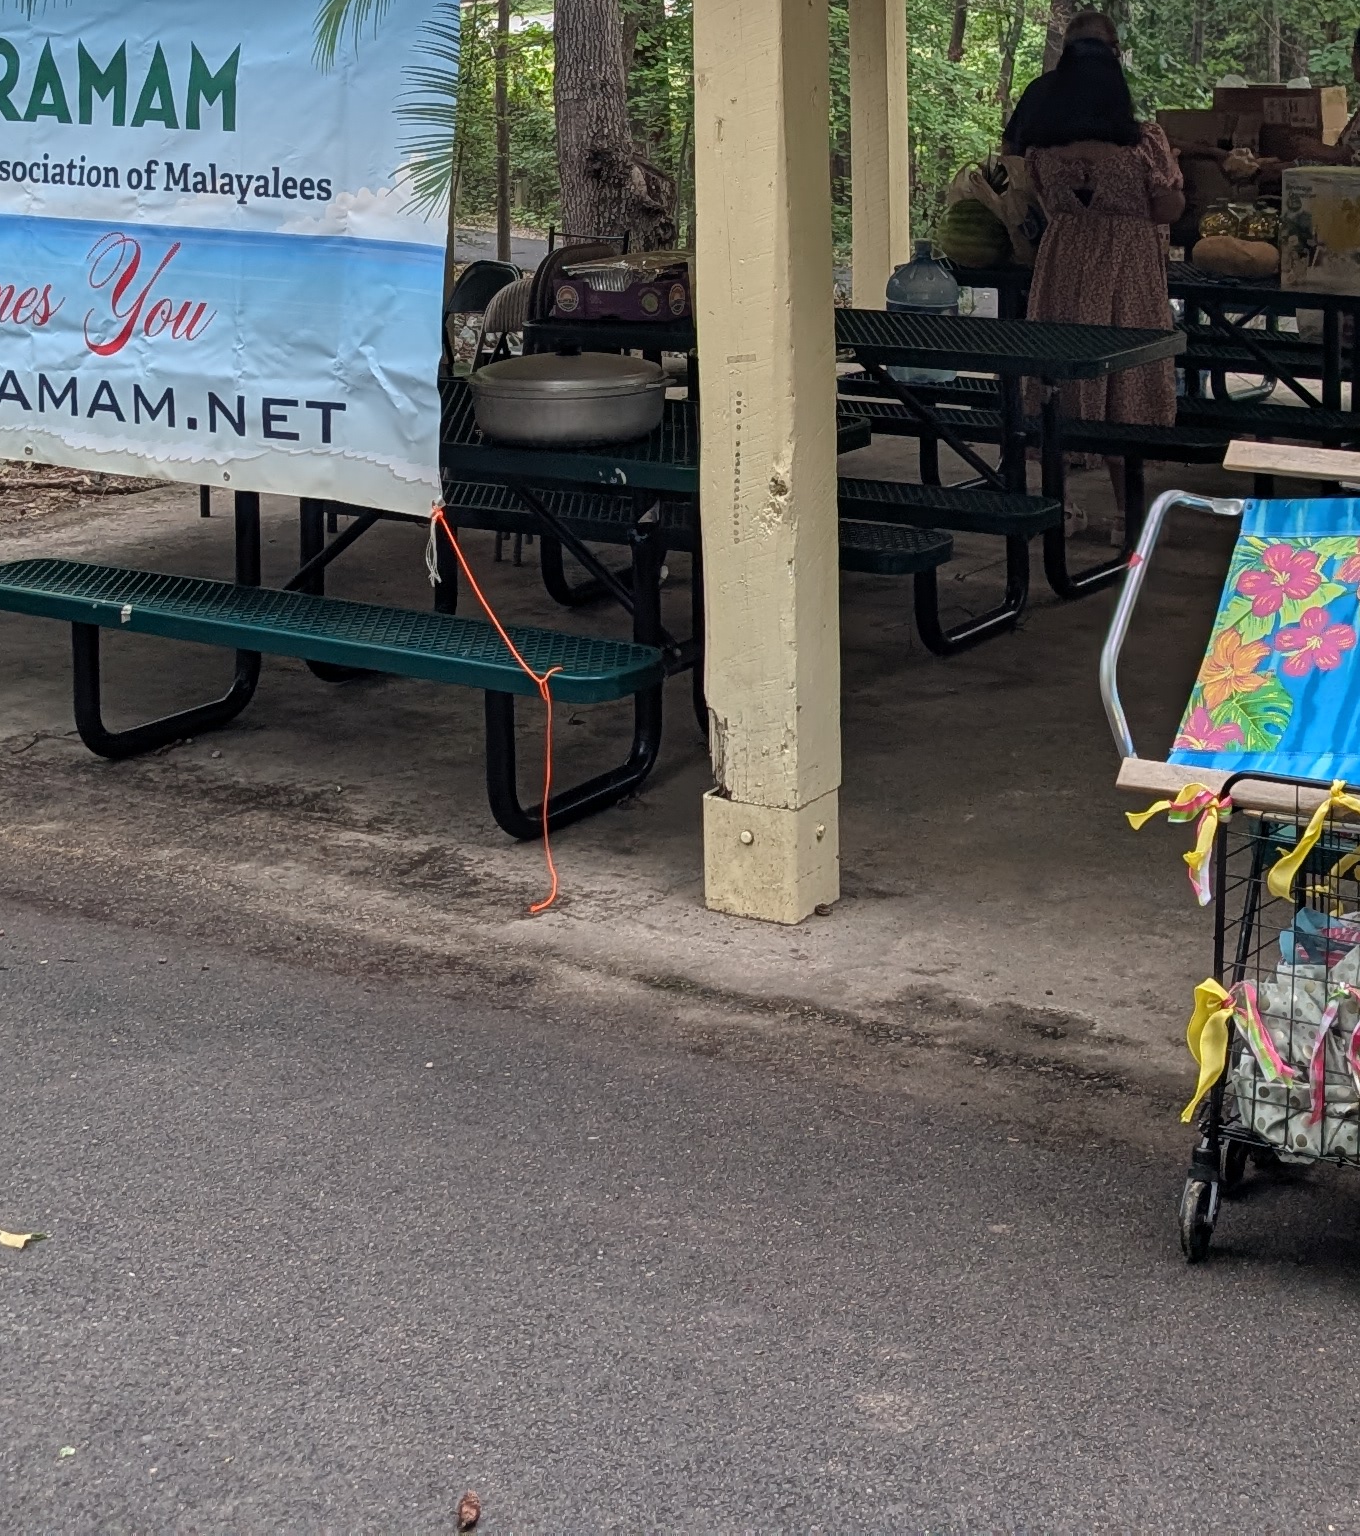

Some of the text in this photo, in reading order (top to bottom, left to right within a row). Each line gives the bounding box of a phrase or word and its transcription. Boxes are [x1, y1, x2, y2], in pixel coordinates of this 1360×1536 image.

[126, 159, 160, 191] of
[163, 161, 333, 205] Malayalees
[84, 232, 217, 357] You
